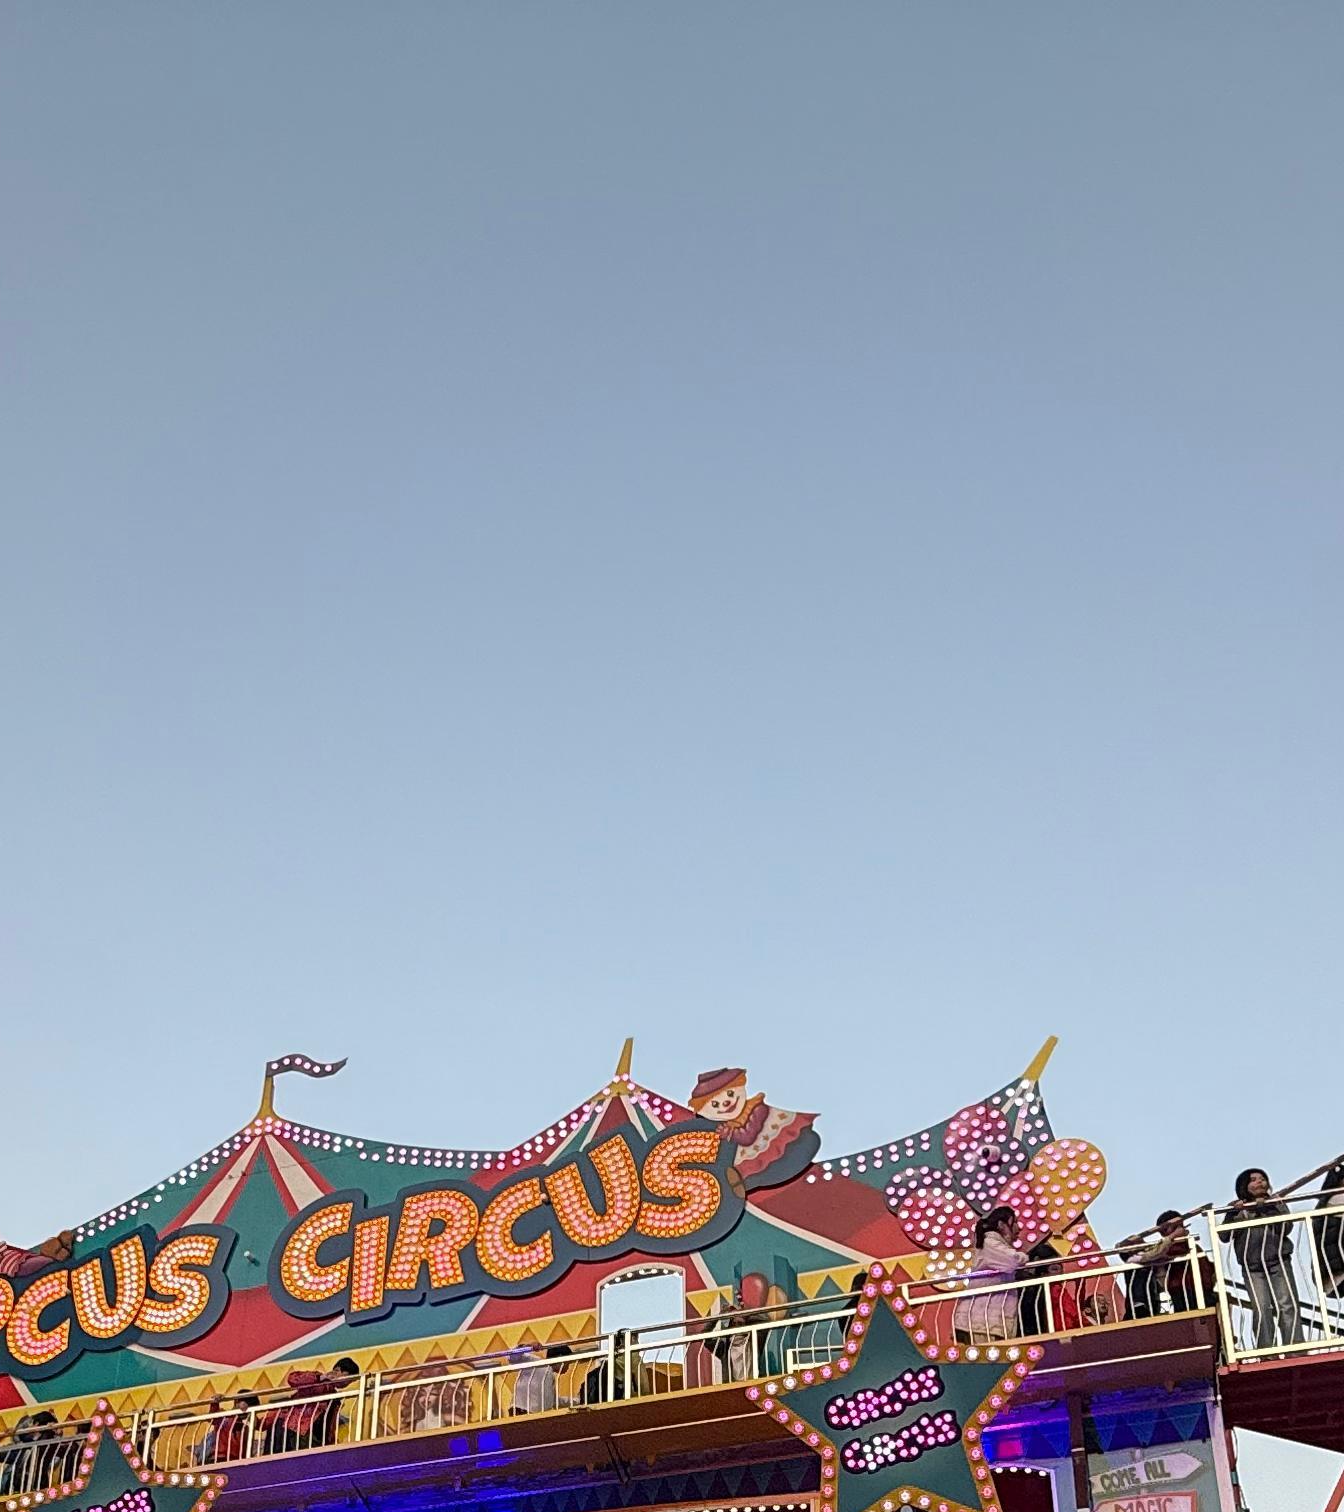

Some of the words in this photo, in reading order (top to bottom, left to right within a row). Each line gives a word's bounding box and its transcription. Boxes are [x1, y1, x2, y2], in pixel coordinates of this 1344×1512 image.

[279, 1130, 723, 1313] CIRCUS
[1100, 1467, 1140, 1491] COME
[1144, 1459, 1171, 1481] ALL
